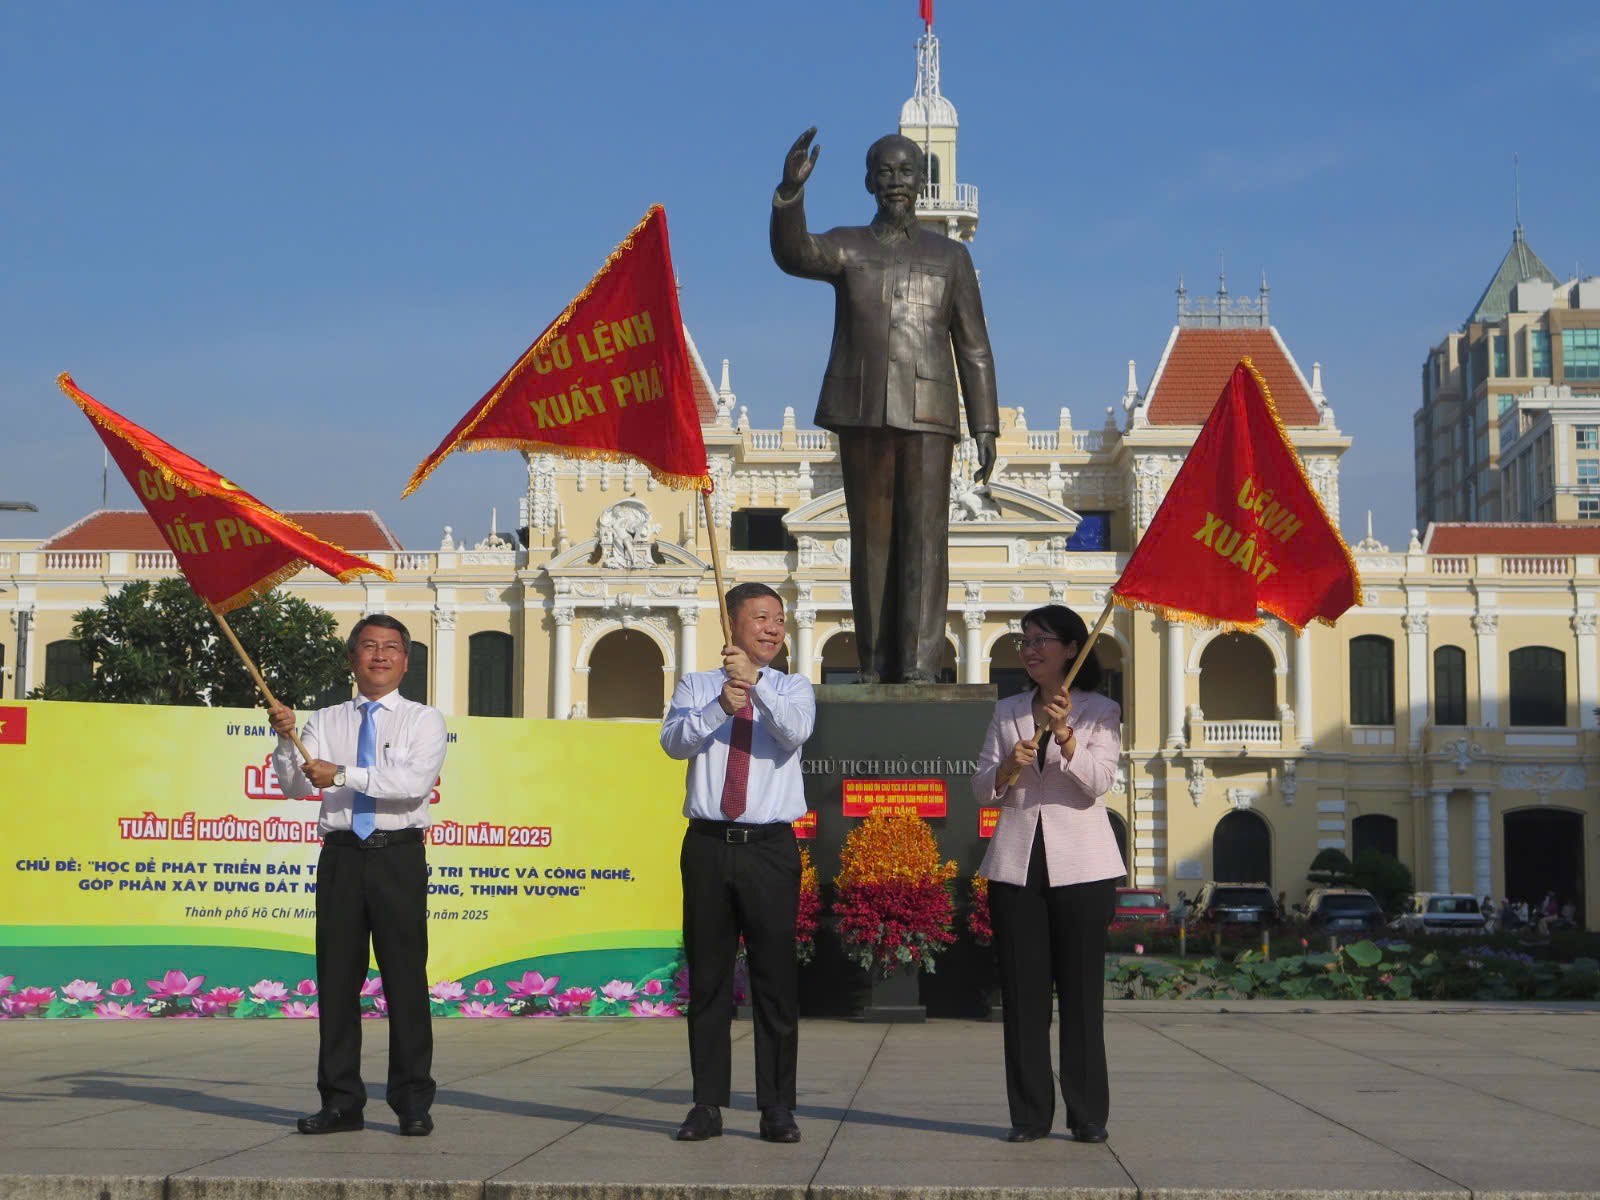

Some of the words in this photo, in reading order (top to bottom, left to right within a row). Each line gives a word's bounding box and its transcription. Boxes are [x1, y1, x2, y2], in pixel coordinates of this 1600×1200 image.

[577, 310, 655, 364] LỆNH
[529, 377, 606, 429] XUẤT
[611, 360, 664, 408] PHÁ
[165, 513, 209, 554] ẤT
[215, 517, 271, 550] PH
[226, 721, 241, 736] ỦY
[244, 725, 266, 737] BAN
[800, 756, 835, 775] CHỦ
[839, 759, 880, 777] TỊCH
[884, 754, 908, 775] HỒ
[911, 756, 942, 775] CHÍ
[946, 759, 980, 775] MIN
[119, 812, 169, 839] TUẦN
[171, 812, 195, 840] LỄ
[198, 814, 261, 842] HƯỞNG
[264, 816, 301, 842] ỨNG
[431, 820, 463, 846] ĐỜI
[466, 821, 506, 847] NĂM
[508, 826, 552, 847] 2025
[16, 857, 50, 871] CHỦ
[55, 857, 82, 872] ĐỀ:
[88, 860, 130, 874] "HỌC
[135, 857, 156, 873] ĐỂ
[162, 860, 207, 874] PHÁT
[213, 858, 261, 875] TRIỂN
[266, 861, 301, 875] BẢN
[438, 866, 463, 878] TRI
[469, 865, 510, 879] THỨC
[515, 866, 539, 879] VÀ
[544, 867, 586, 879] CÔNG
[590, 868, 635, 882] NGHỆ,
[79, 877, 114, 891] GÓP
[119, 876, 166, 891] PHẦN
[172, 878, 208, 892] XÂY
[213, 880, 260, 894] DỰNG
[265, 878, 299, 893] ĐẤT
[427, 884, 464, 897] ỜNG,
[471, 885, 518, 898] THỊNH
[523, 886, 586, 898] VƯỢNG"
[185, 906, 222, 918] Thành
[225, 906, 248, 920] phố
[252, 907, 268, 918] Hồ
[271, 907, 291, 919] Chí
[293, 908, 316, 919] Min
[434, 910, 459, 920] năm
[462, 910, 489, 920] 2025
